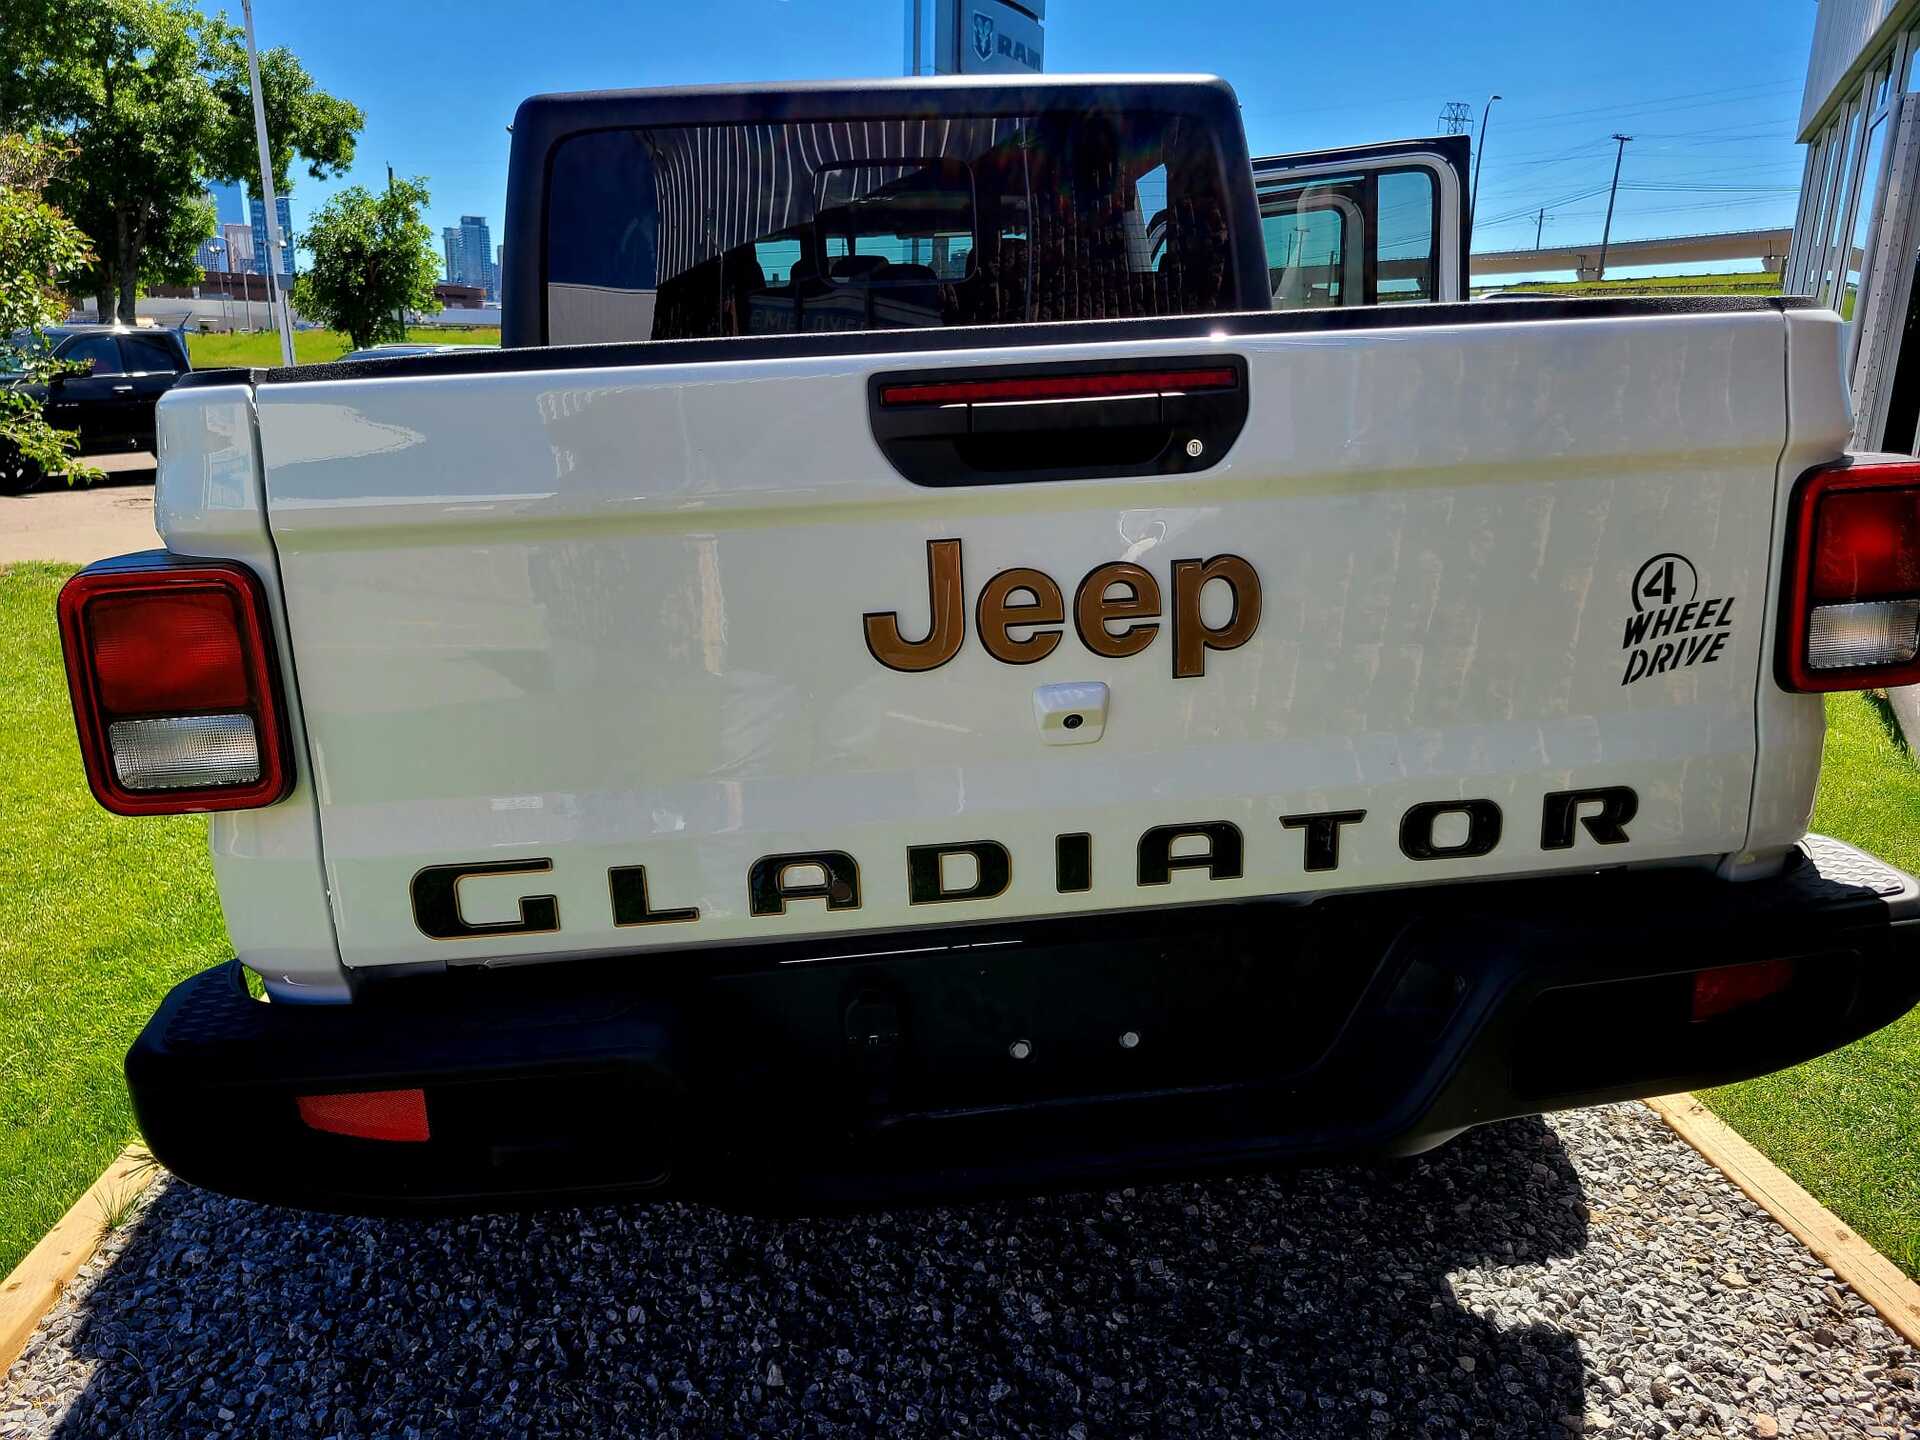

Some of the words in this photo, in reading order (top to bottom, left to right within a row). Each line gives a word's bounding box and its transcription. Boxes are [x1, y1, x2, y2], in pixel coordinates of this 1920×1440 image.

[997, 33, 1041, 72] RAM
[863, 538, 1262, 679] Jeep
[1642, 561, 1677, 605] 4
[1622, 597, 1736, 650] WHEEL
[1621, 632, 1731, 686] DRIVE
[408, 785, 1639, 941] GLADIATOR
